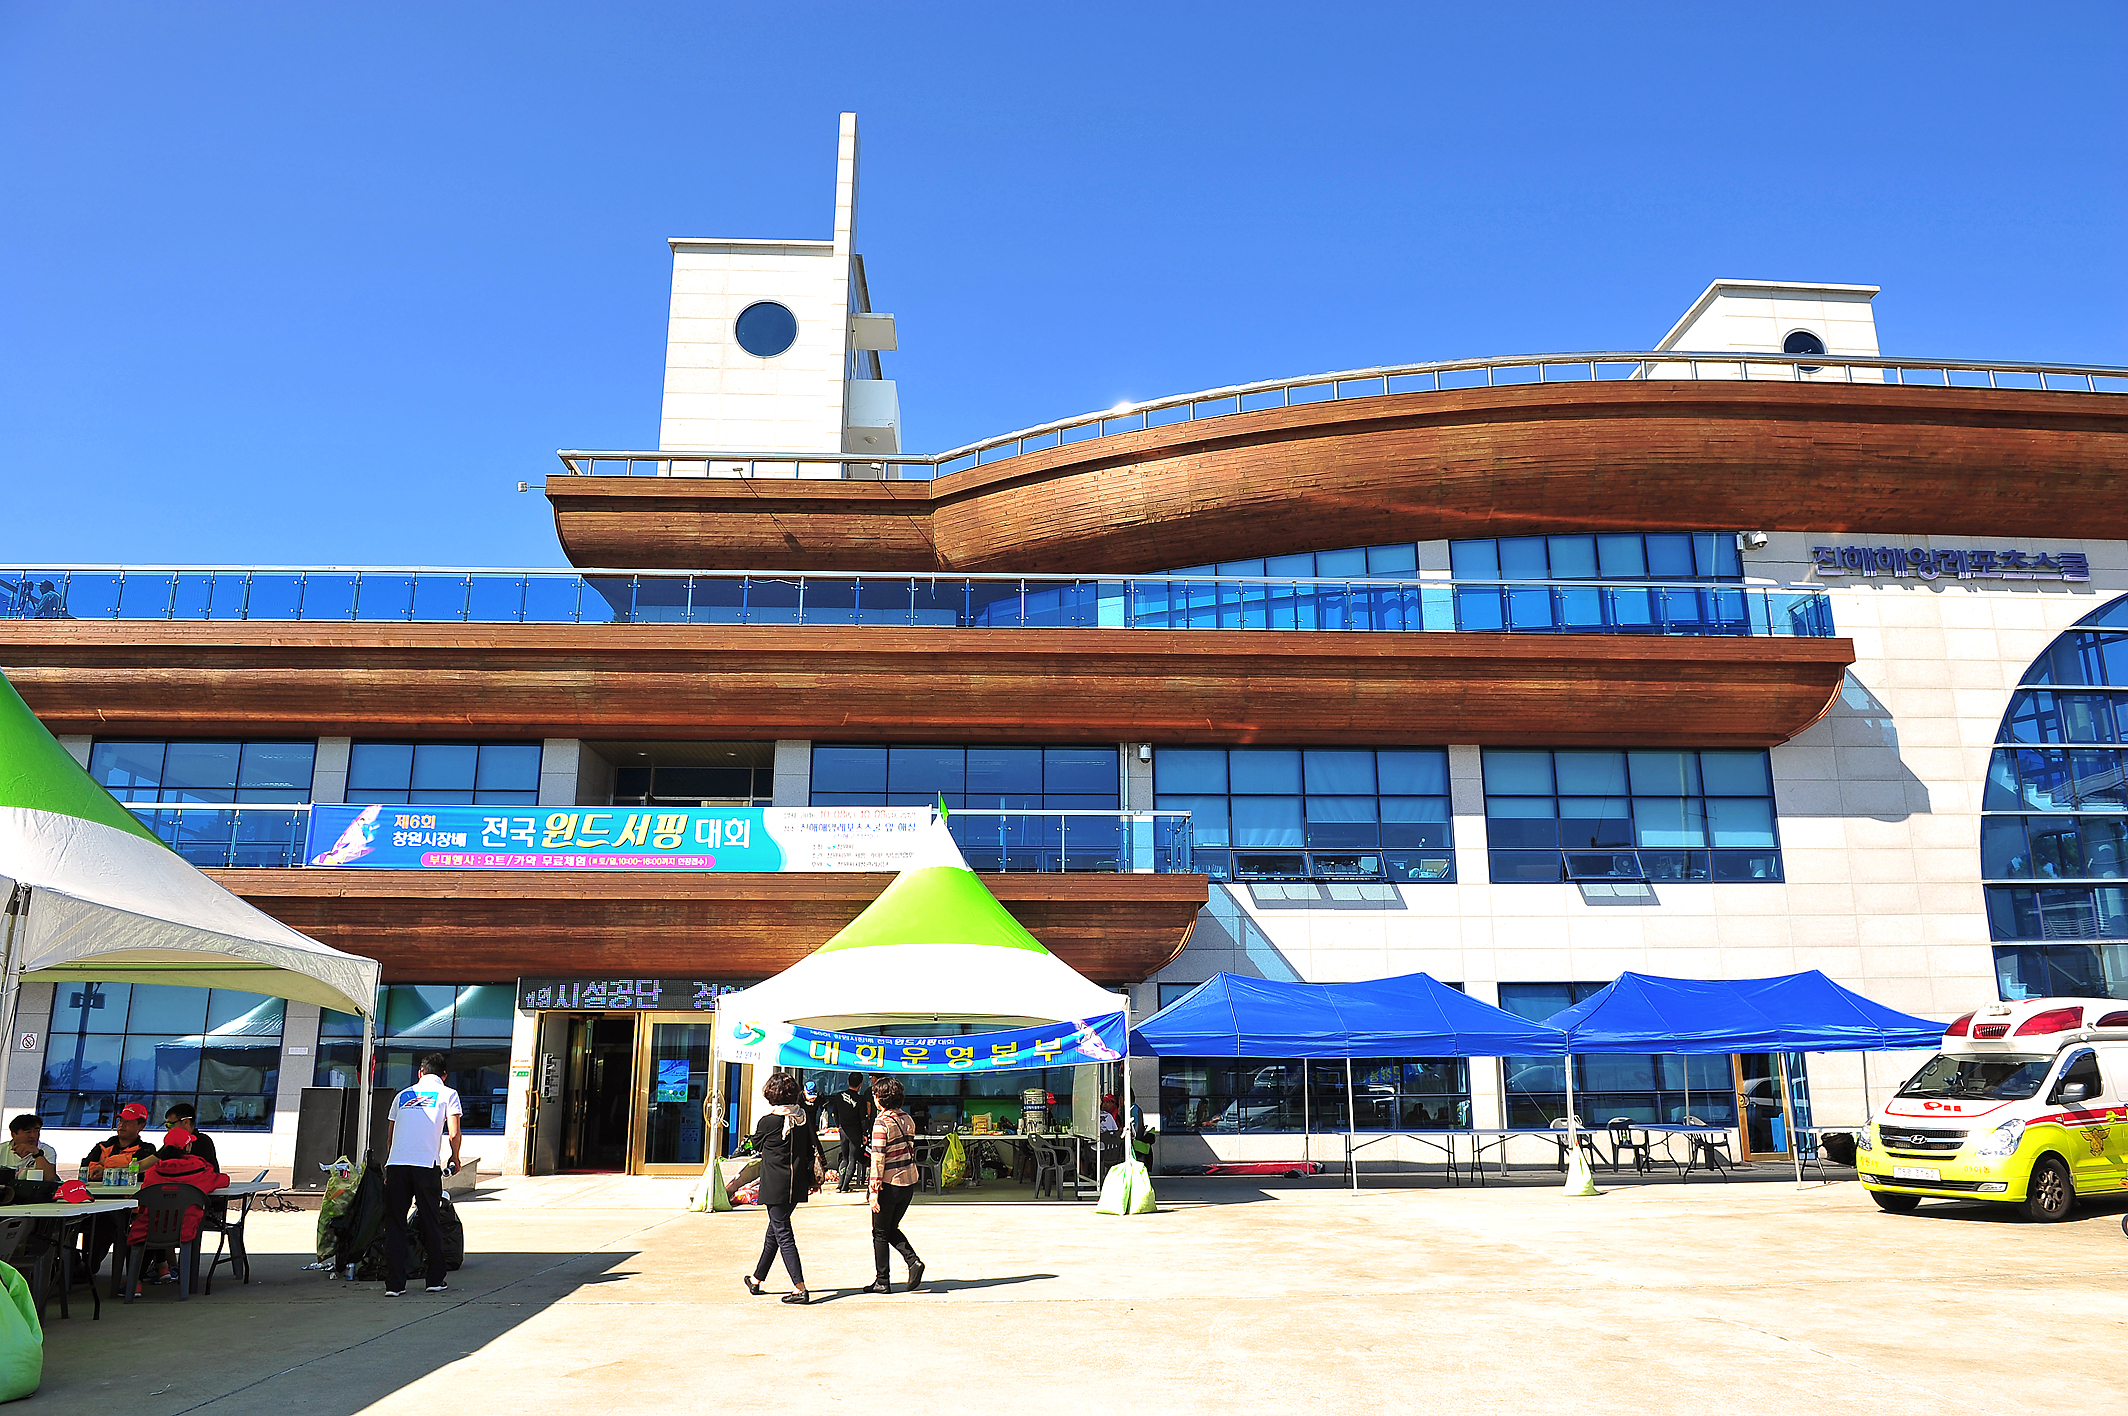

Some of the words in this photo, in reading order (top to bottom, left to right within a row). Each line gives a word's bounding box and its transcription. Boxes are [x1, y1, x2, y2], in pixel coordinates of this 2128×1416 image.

[1812, 546, 2091, 582] 진해해양레포츠스쿨
[393, 814, 436, 829] 제6회
[480, 816, 536, 848] 전국
[541, 812, 689, 849] 윈드서핑
[694, 818, 752, 849] 대회
[392, 832, 467, 848] 창원시장배
[483, 855, 536, 867] 요트/카약
[541, 855, 586, 867] 무료체험
